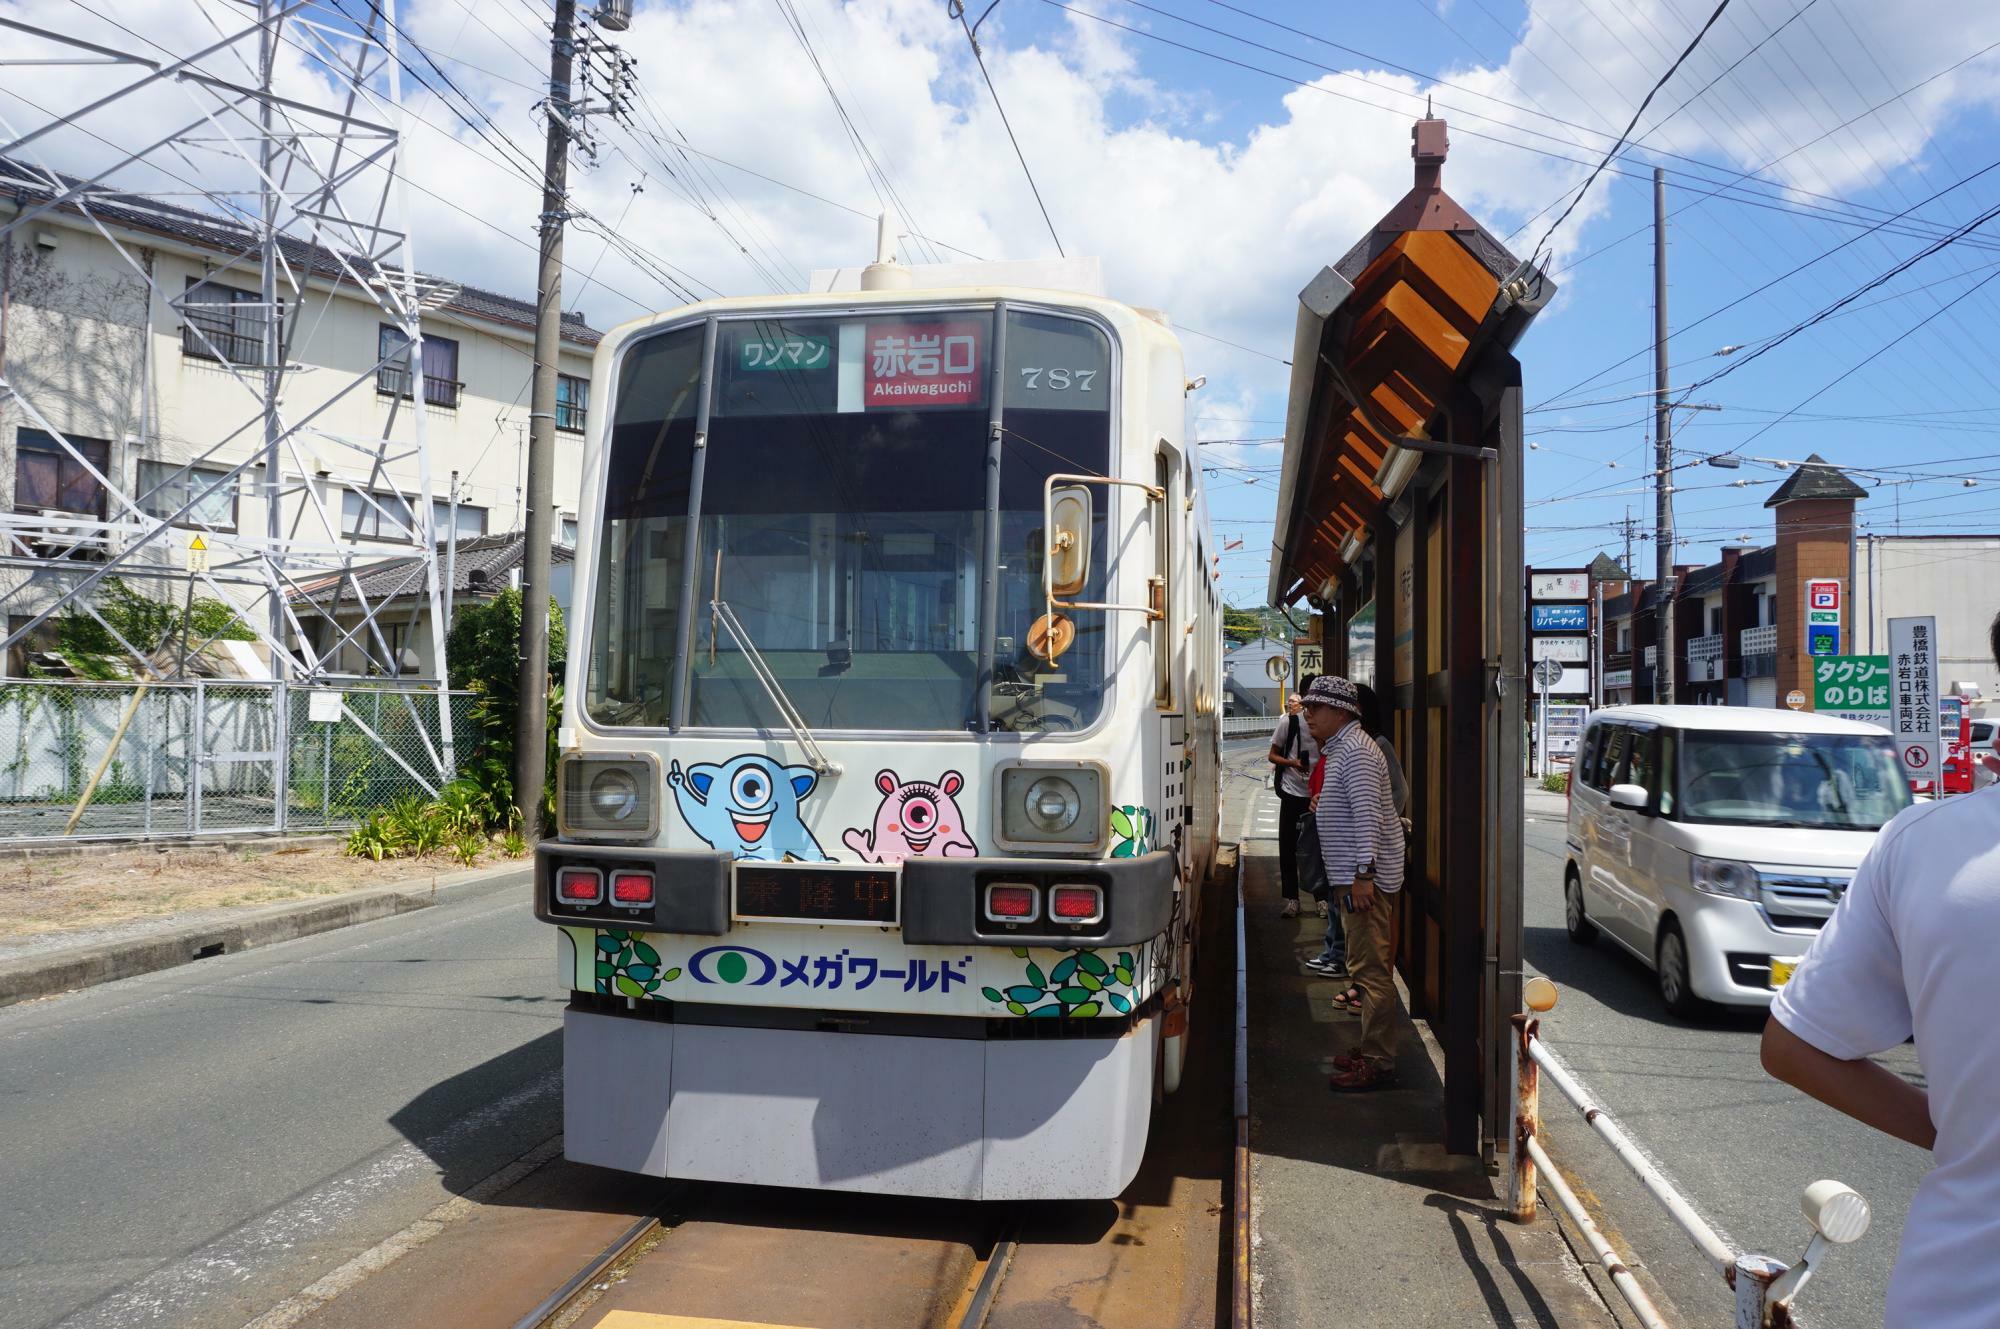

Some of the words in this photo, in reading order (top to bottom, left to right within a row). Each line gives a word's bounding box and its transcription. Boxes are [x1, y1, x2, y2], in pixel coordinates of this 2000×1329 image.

[744, 341, 825, 367] ワンマン
[872, 334, 975, 378] 赤岩口
[873, 380, 972, 396] Akaiwaguchi
[1021, 367, 1097, 391] 787
[1818, 595, 1831, 605] P
[1536, 617, 1585, 626] リバーサイド
[1816, 660, 1889, 683] タクシー
[1912, 625, 1932, 733] 豊橋鉄道株式会社
[1824, 685, 1888, 705] のりば
[1898, 653, 1914, 733] 赤岩口車両区
[780, 949, 973, 993] メガワールド
